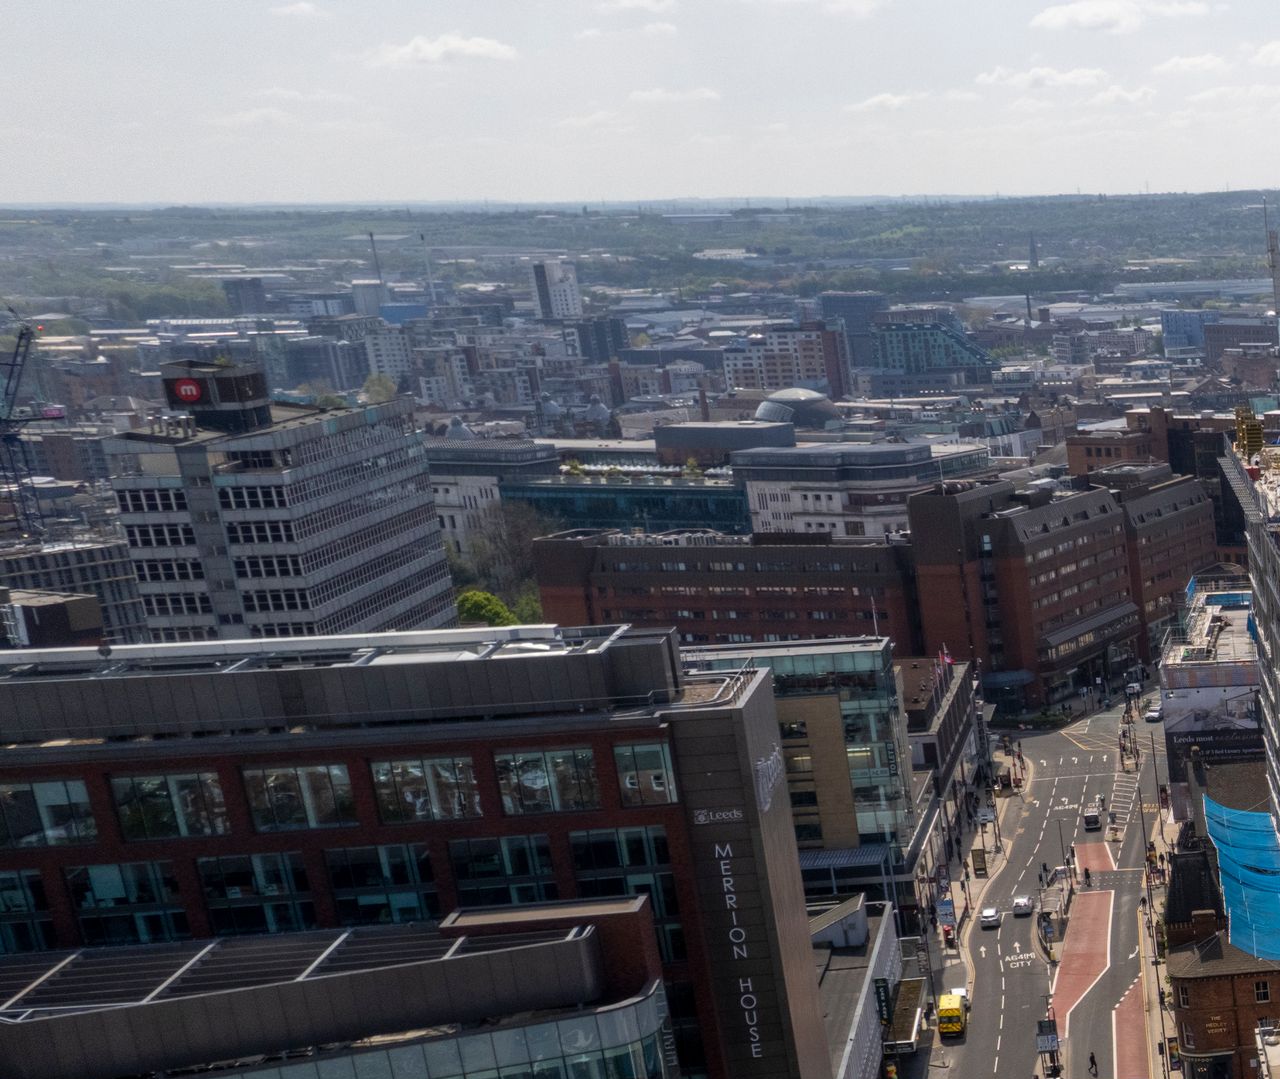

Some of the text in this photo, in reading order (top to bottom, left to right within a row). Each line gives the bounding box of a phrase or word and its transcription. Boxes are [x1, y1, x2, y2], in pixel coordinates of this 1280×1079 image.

[887, 749, 897, 776] TO LET
[709, 809, 743, 820] Leeds
[715, 843, 763, 1058] MERRION HOUSE
[1005, 952, 1036, 963] A64(M)
[1010, 960, 1032, 969] CITY
